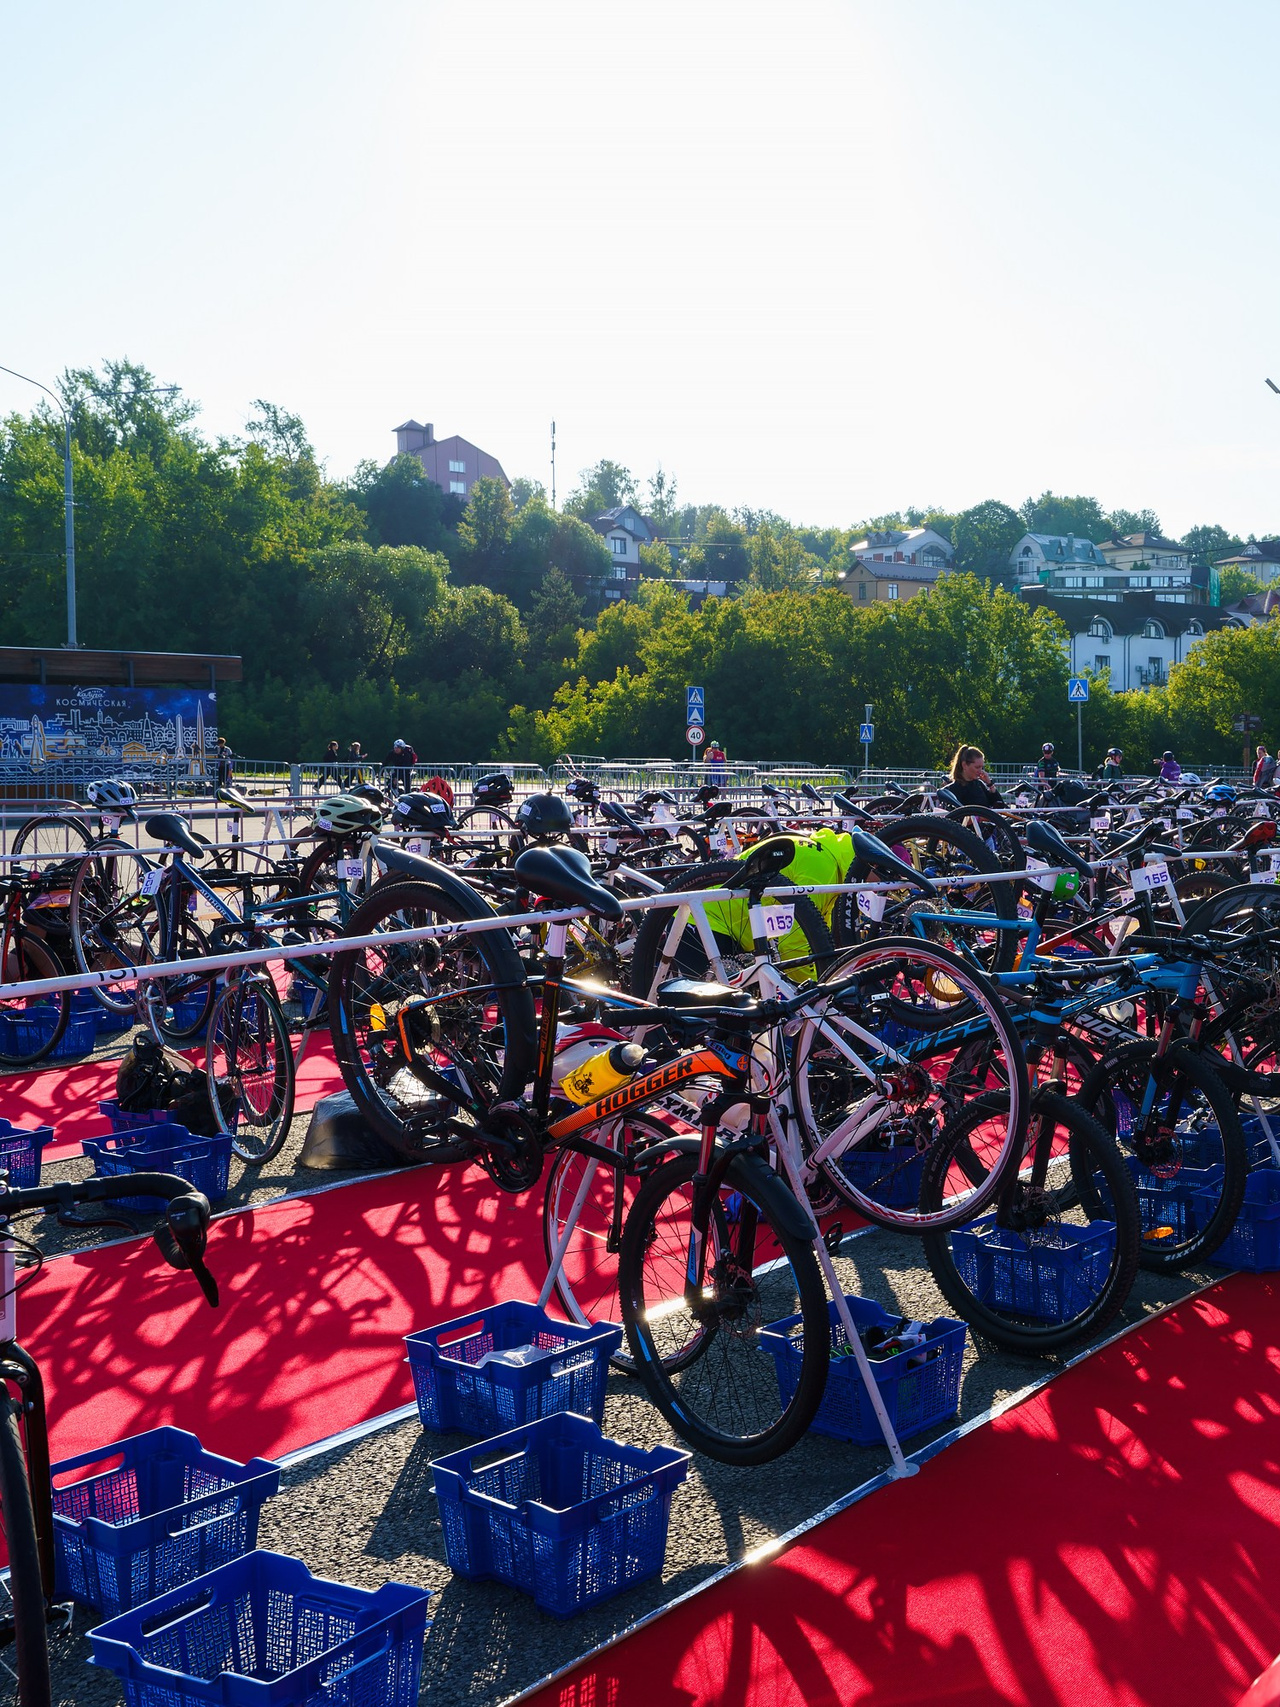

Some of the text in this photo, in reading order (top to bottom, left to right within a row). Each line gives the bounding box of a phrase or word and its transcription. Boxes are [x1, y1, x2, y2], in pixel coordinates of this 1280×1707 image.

[56, 698, 127, 707] КОСМИЧЕСКАЯ
[690, 731, 701, 740] 40
[346, 866, 362, 876] 095
[1144, 871, 1169, 886] 155
[845, 876, 857, 930] MAXXS
[766, 915, 793, 931] 153
[595, 1056, 694, 1118] HOGGER
[1163, 1235, 1206, 1263] MAXXIS
